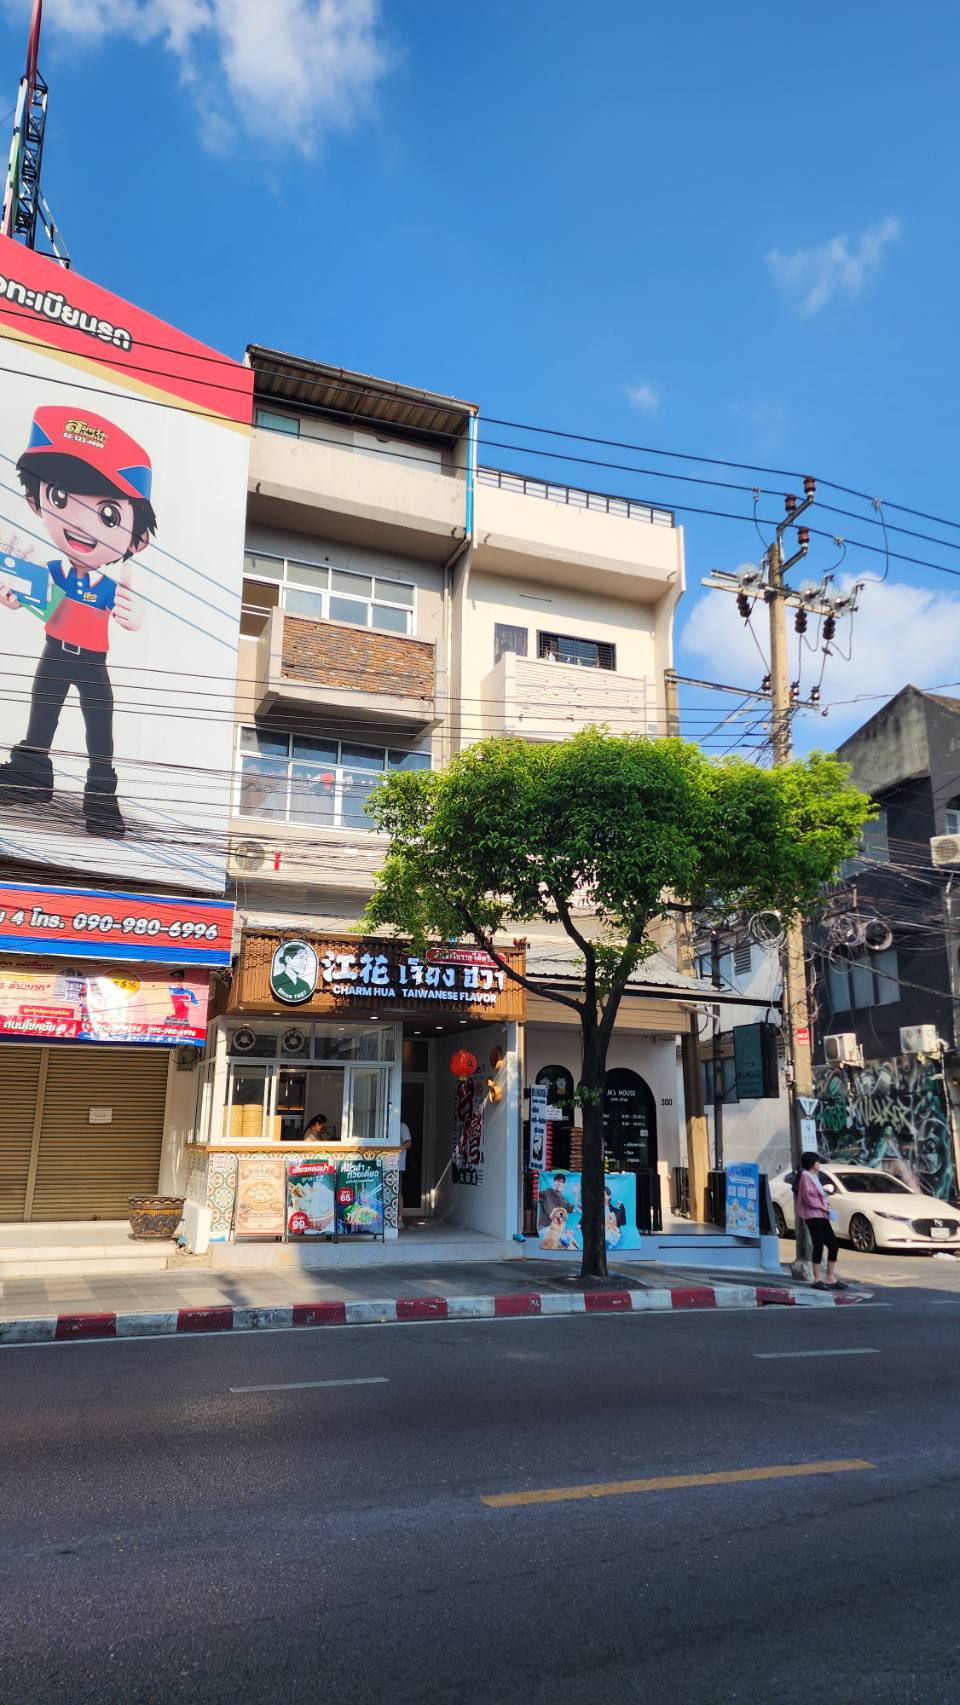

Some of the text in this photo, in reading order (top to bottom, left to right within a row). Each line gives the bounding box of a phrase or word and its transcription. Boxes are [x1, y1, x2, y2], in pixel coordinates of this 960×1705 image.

[11, 910, 25, 925] 4
[72, 912, 219, 941] 090-980-6996
[321, 950, 390, 985] 江花
[333, 985, 497, 1003] CHARM HUA TAIWANESE FLAVOR
[618, 1089, 637, 1097] HOUSE
[660, 1098, 673, 1106] 300
